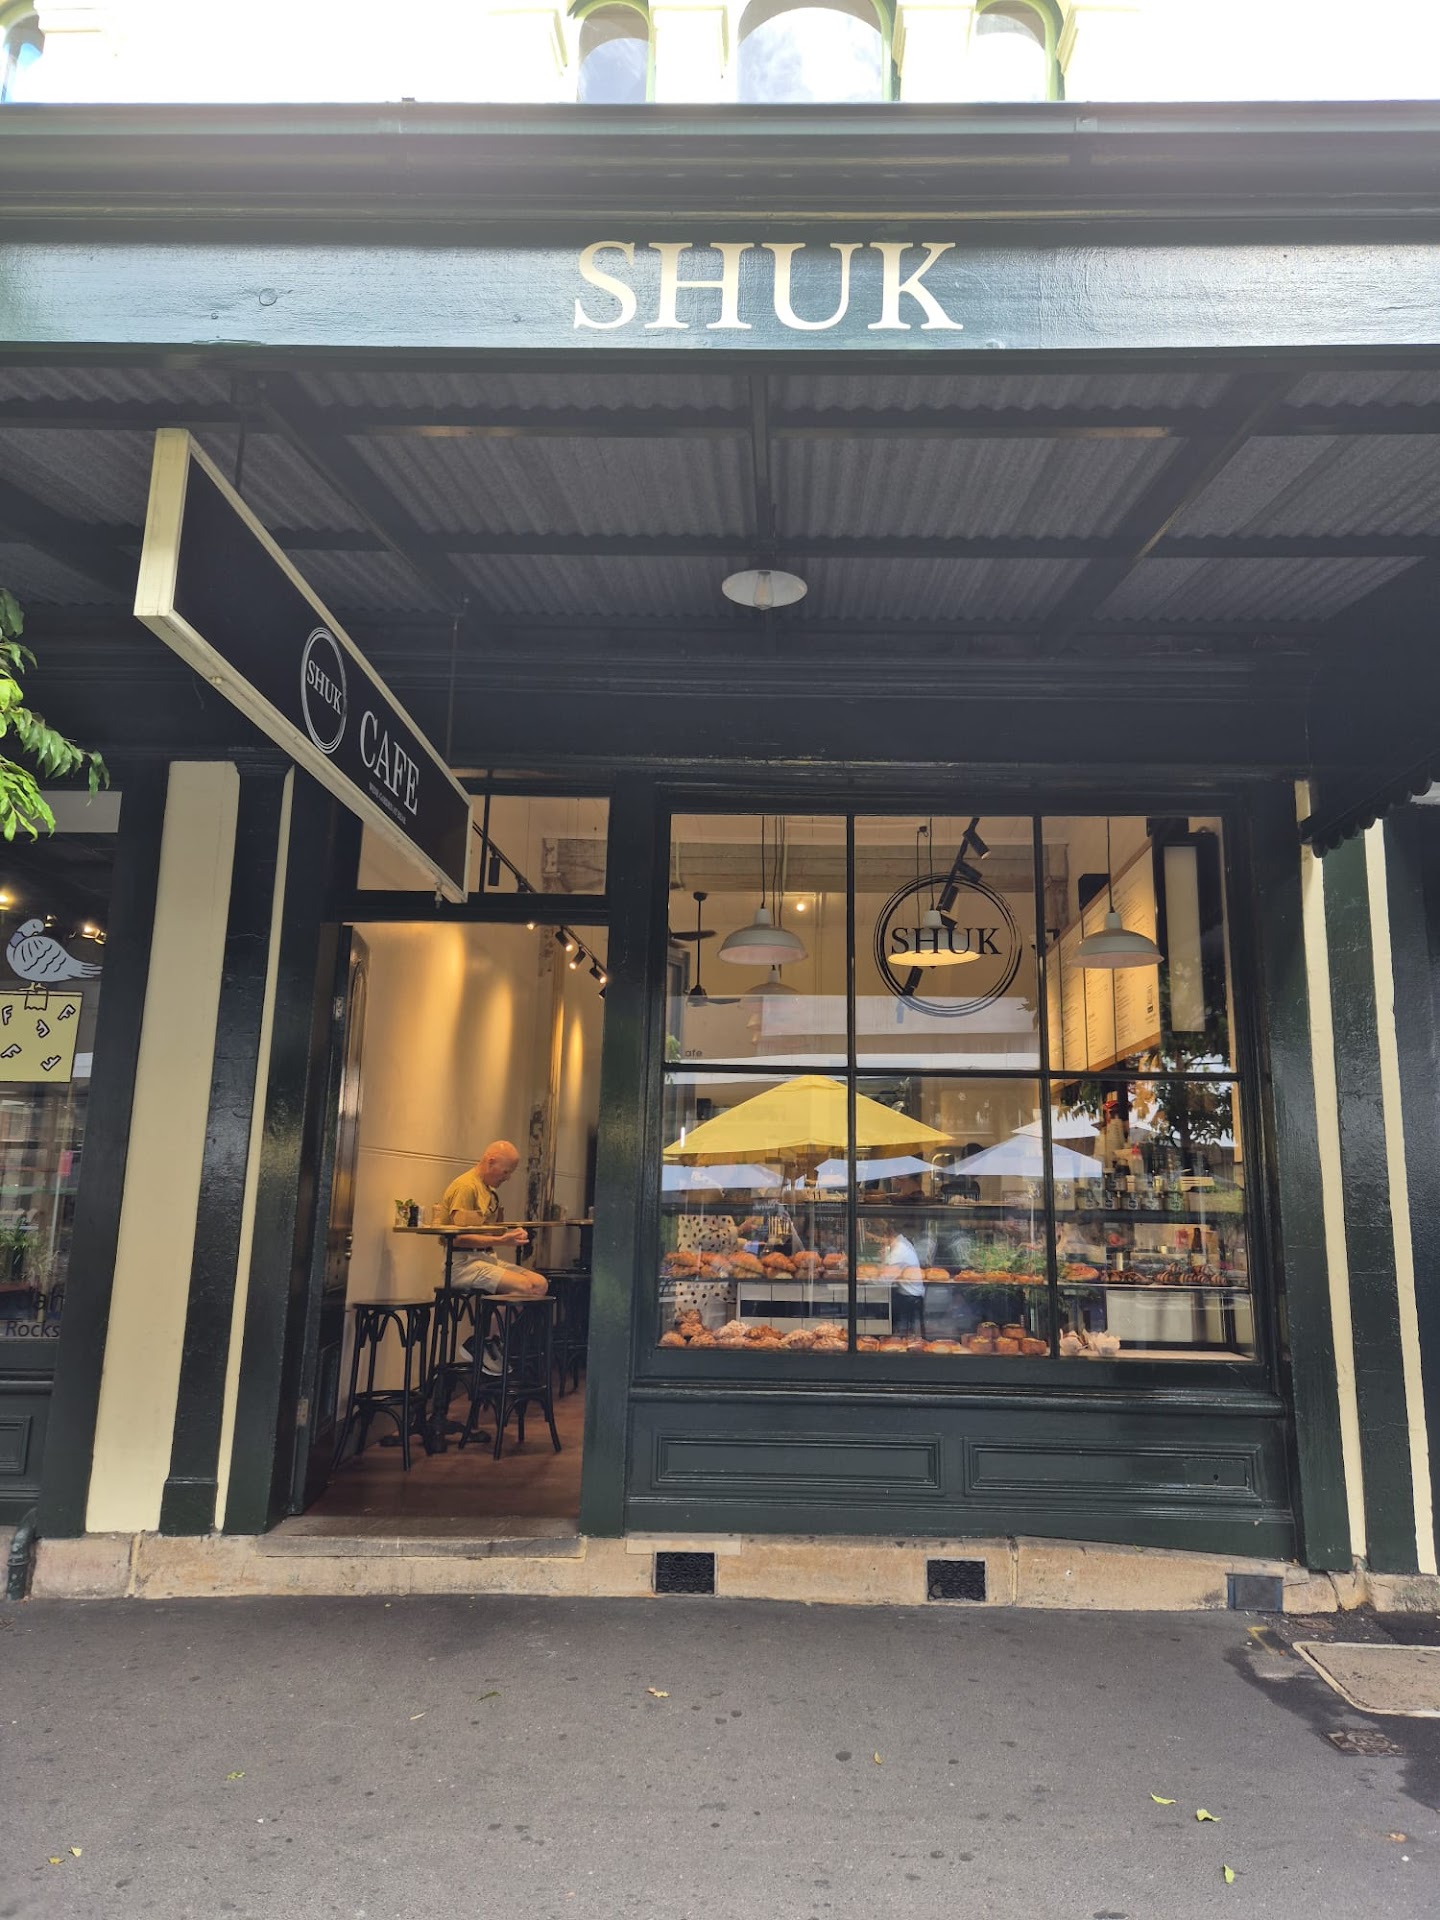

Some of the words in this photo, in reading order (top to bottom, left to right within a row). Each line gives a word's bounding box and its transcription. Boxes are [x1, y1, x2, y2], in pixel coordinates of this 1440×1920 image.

[573, 241, 963, 330] SHUK
[306, 659, 343, 715] SHUK
[359, 710, 420, 816] CAFE
[891, 927, 1002, 955] SHUK
[5, 1319, 61, 1338] Rocks
